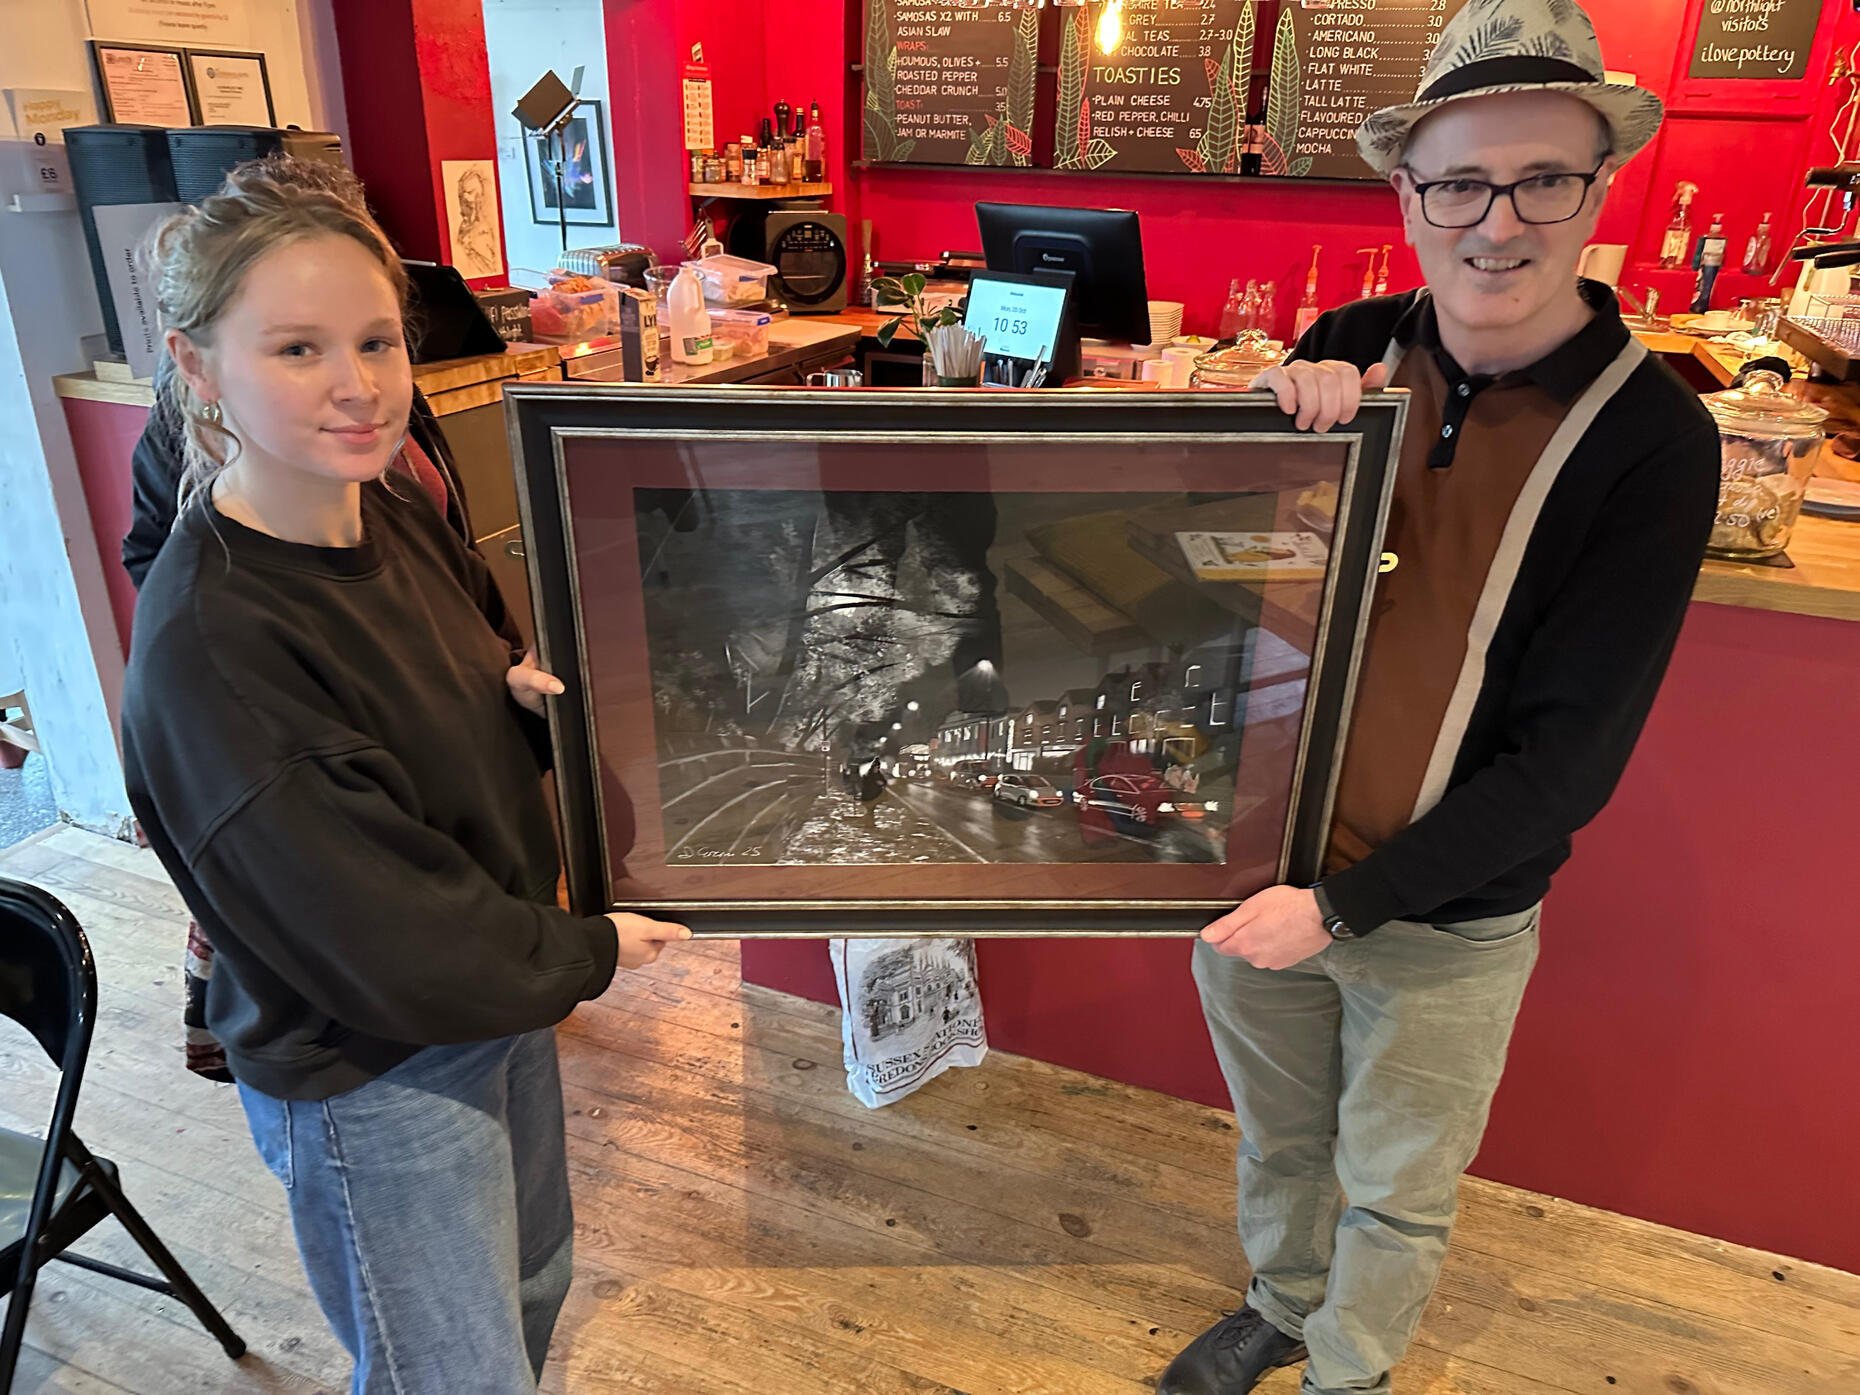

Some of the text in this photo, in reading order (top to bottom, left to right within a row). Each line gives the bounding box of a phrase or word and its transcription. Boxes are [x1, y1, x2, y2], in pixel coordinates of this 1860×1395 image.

[1329, 0, 1447, 11] PRESSO 2.8
[897, 11, 937, 22] SAMOSAS
[940, 11, 953, 22] X2
[955, 11, 979, 22] WITH
[1129, 14, 1158, 25] GREY
[1313, 13, 1443, 28] CORTADO 3.0
[1721, 16, 1769, 32] visitors
[897, 26, 951, 37] ASIAN SLAW
[1144, 30, 1170, 42] TEAS
[1312, 30, 1440, 45] AMERICANO 3.0
[1121, 46, 1180, 57] CHOCOLATE
[1309, 46, 1340, 58] LONG
[1343, 47, 1379, 59] BLACK
[943, 56, 974, 67] OLIVES
[1308, 62, 1335, 75] FLAT
[1340, 63, 1374, 76] WHITE
[897, 71, 977, 82] ROASTED PEPPER
[1093, 66, 1182, 85] TOASTIES
[895, 85, 937, 96] CHEDDAR
[941, 86, 979, 96] CRUNCH
[1305, 79, 1343, 92] LATTE
[1095, 94, 1125, 106] PLAIN
[1130, 95, 1171, 106] CHEESE
[1304, 95, 1366, 108] TALL LATTE
[897, 114, 931, 125] PEANUT
[1095, 111, 1115, 121] RED
[1160, 111, 1190, 122] CHILLI
[1300, 110, 1363, 124] FLAVOURED
[897, 129, 966, 140] JAM OR MARMITE
[1093, 126, 1127, 137] RELISH
[1137, 127, 1174, 138] CHEESE
[1298, 127, 1358, 140] CAPPUCCIN
[1296, 143, 1332, 154] MOCHA
[124, 248, 137, 272] order
[134, 287, 149, 326] available
[994, 317, 1028, 335] 10 53
[866, 1049, 921, 1073] SUSSEX
